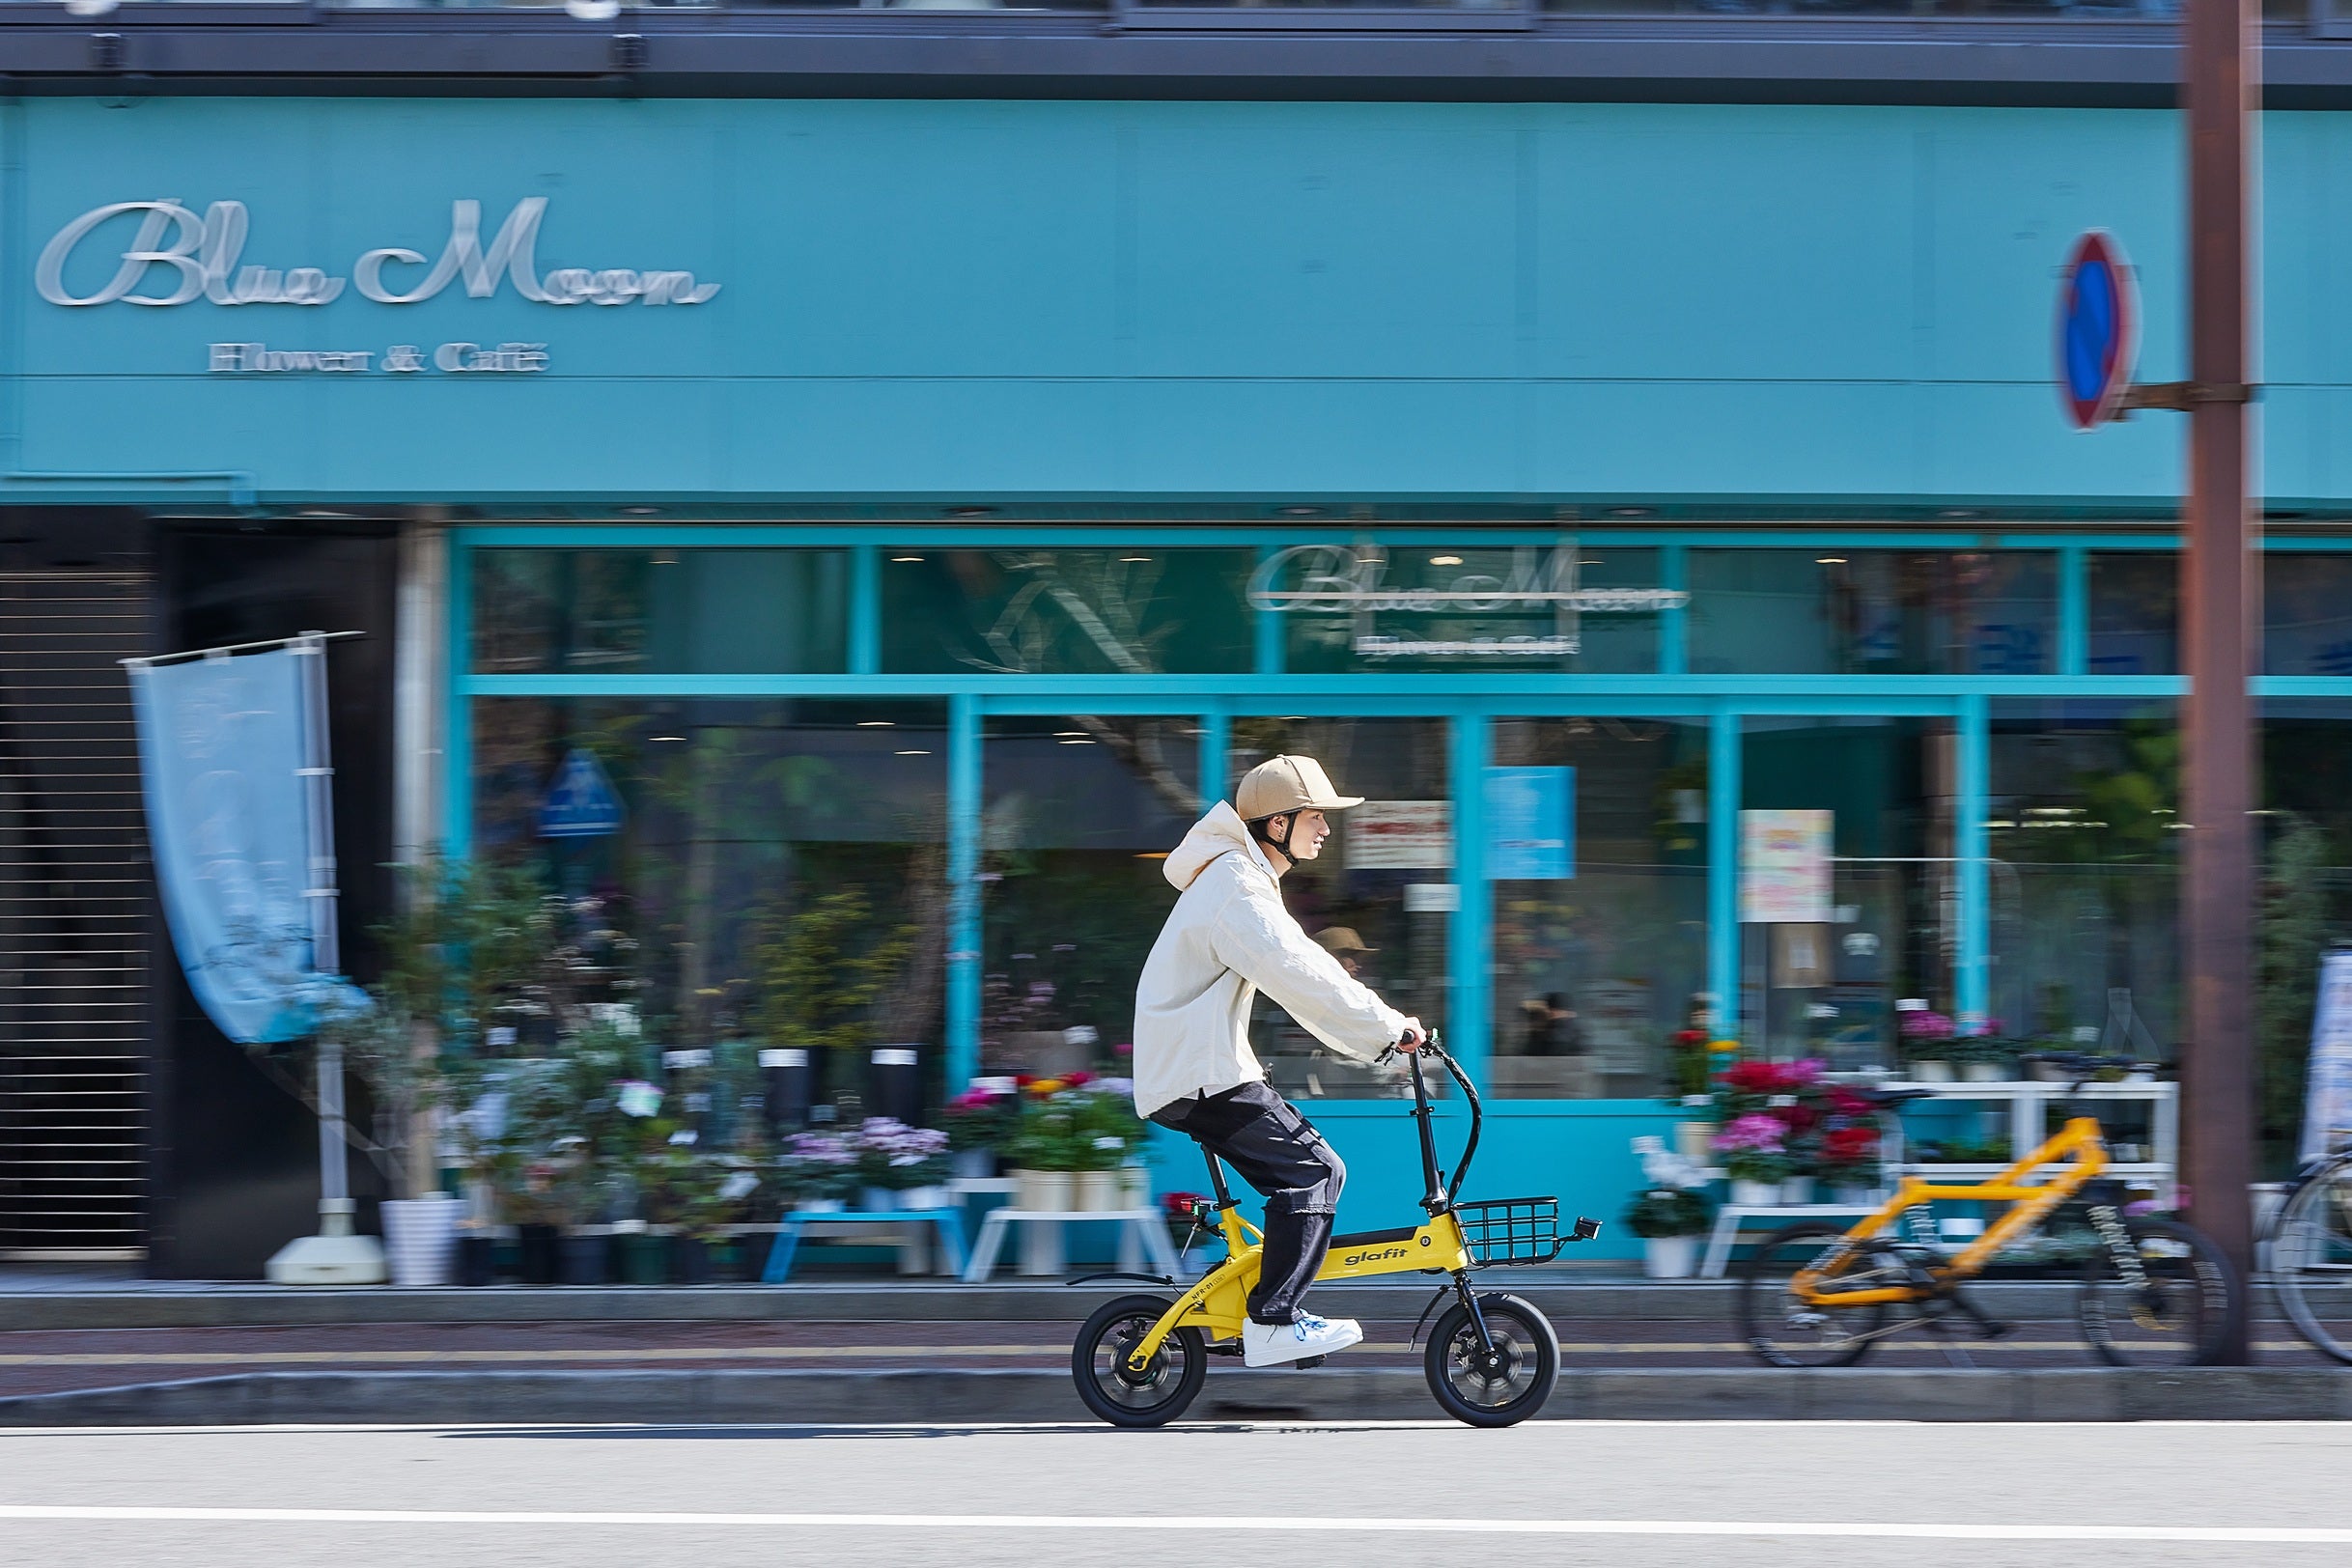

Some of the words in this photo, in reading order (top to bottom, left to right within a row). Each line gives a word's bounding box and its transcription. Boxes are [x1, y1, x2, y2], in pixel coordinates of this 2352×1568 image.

[35, 198, 346, 306] Blue
[352, 196, 722, 305] Moon
[380, 344, 428, 373] &
[1344, 1248, 1408, 1266] glafit
